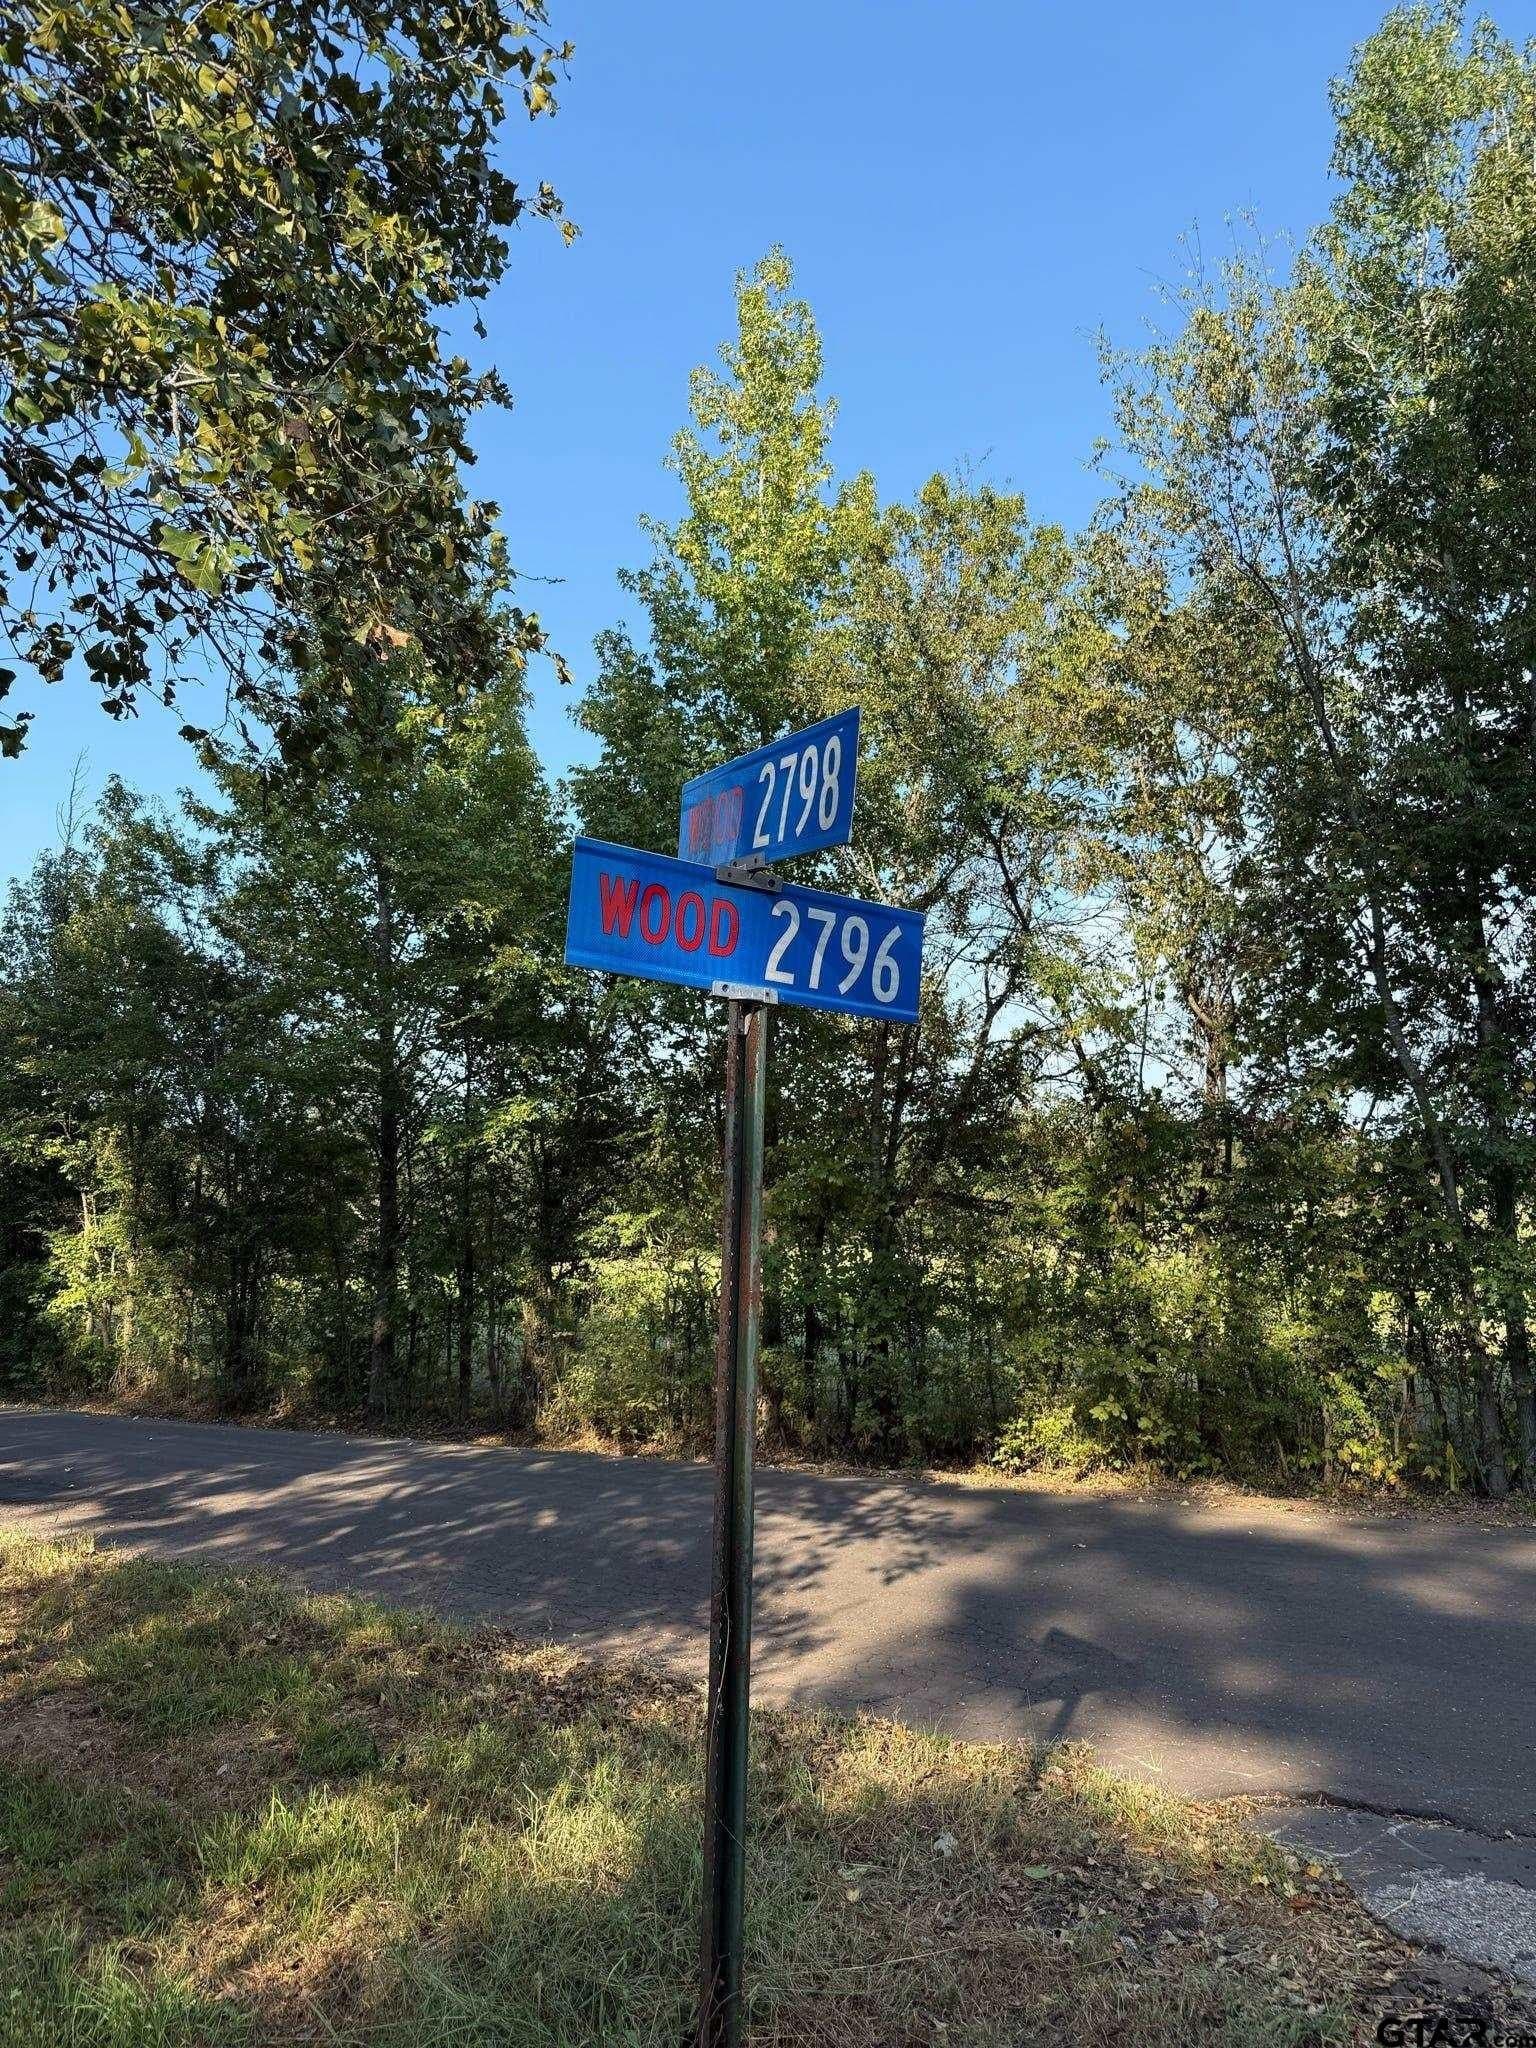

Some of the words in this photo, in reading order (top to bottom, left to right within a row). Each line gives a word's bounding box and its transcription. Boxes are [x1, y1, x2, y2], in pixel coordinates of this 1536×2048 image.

[754, 735, 842, 848] 2798
[600, 872, 740, 957] WOOD
[765, 900, 902, 1002] 2796
